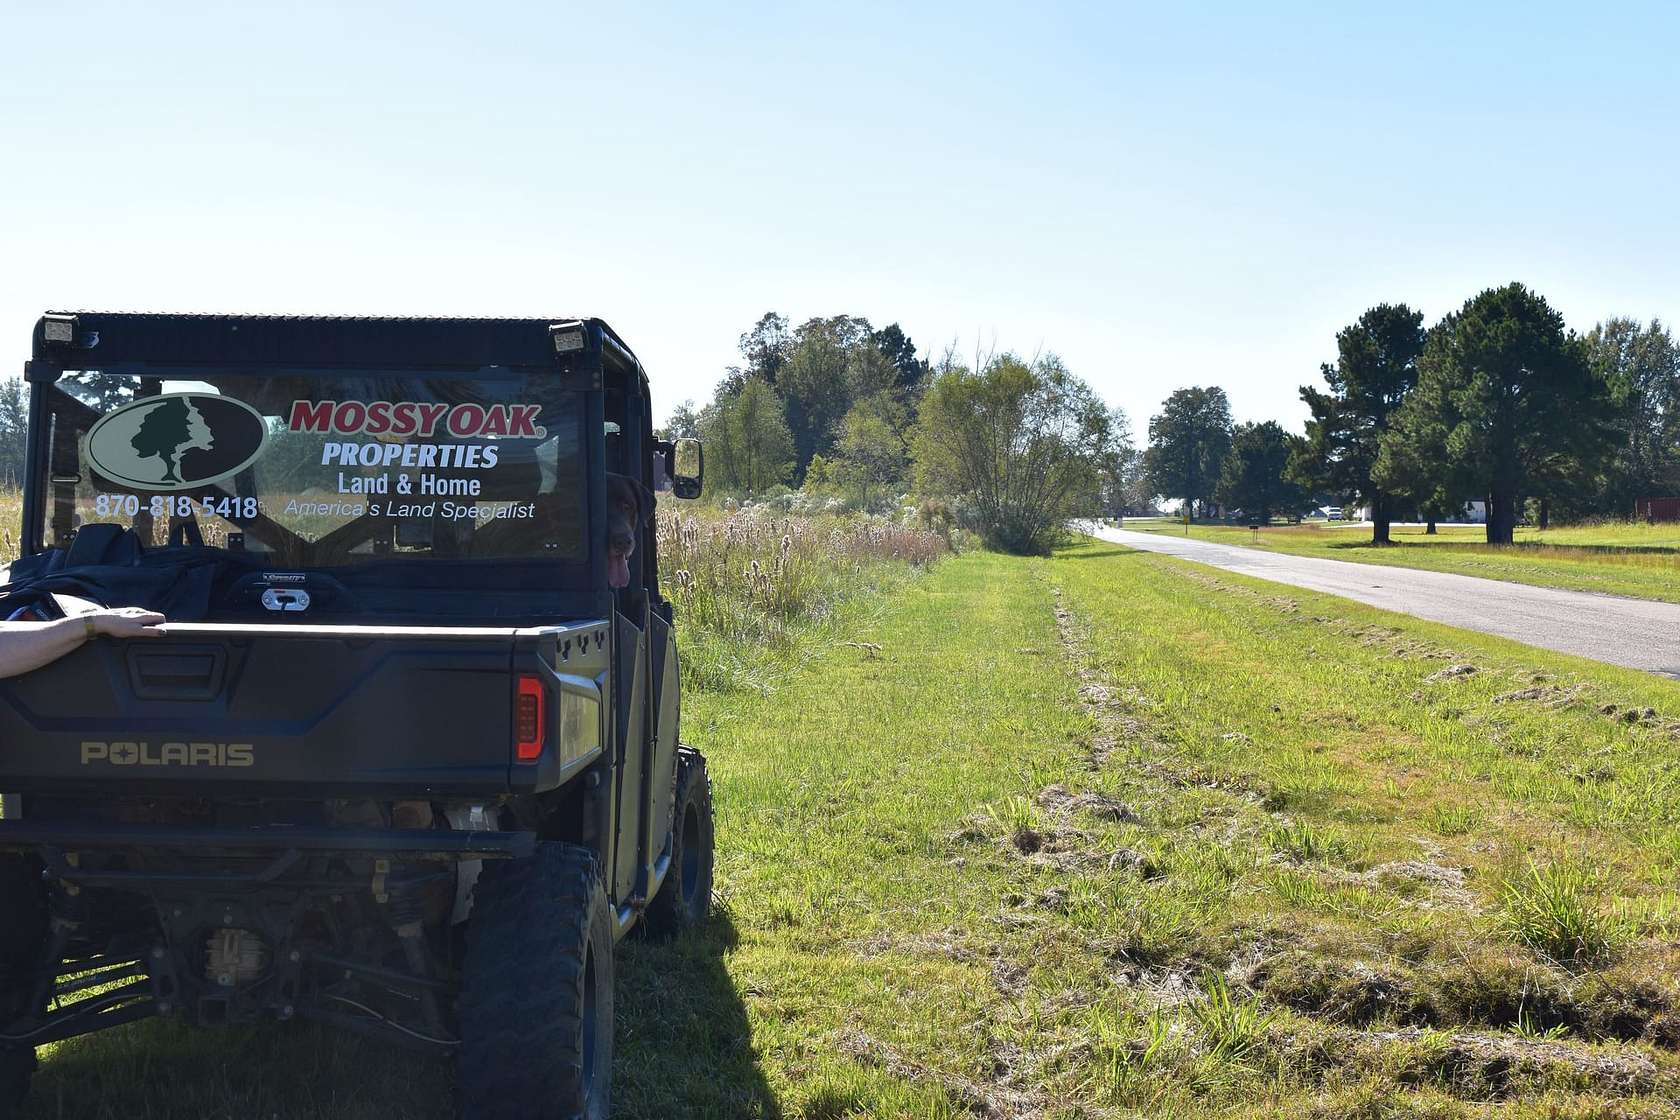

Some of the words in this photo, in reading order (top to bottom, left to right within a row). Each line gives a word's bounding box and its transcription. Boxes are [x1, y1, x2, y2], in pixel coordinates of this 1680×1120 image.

[289, 400, 449, 437] MOSSY
[321, 442, 499, 469] PROPERTIES
[338, 472, 388, 495] Land
[396, 473, 412, 495] &
[421, 474, 481, 496] Home
[95, 494, 258, 519] 870-818-5418
[284, 499, 380, 517] America's
[386, 502, 436, 518] Land
[440, 502, 535, 522] Specialist
[80, 741, 254, 767] POLARIS
